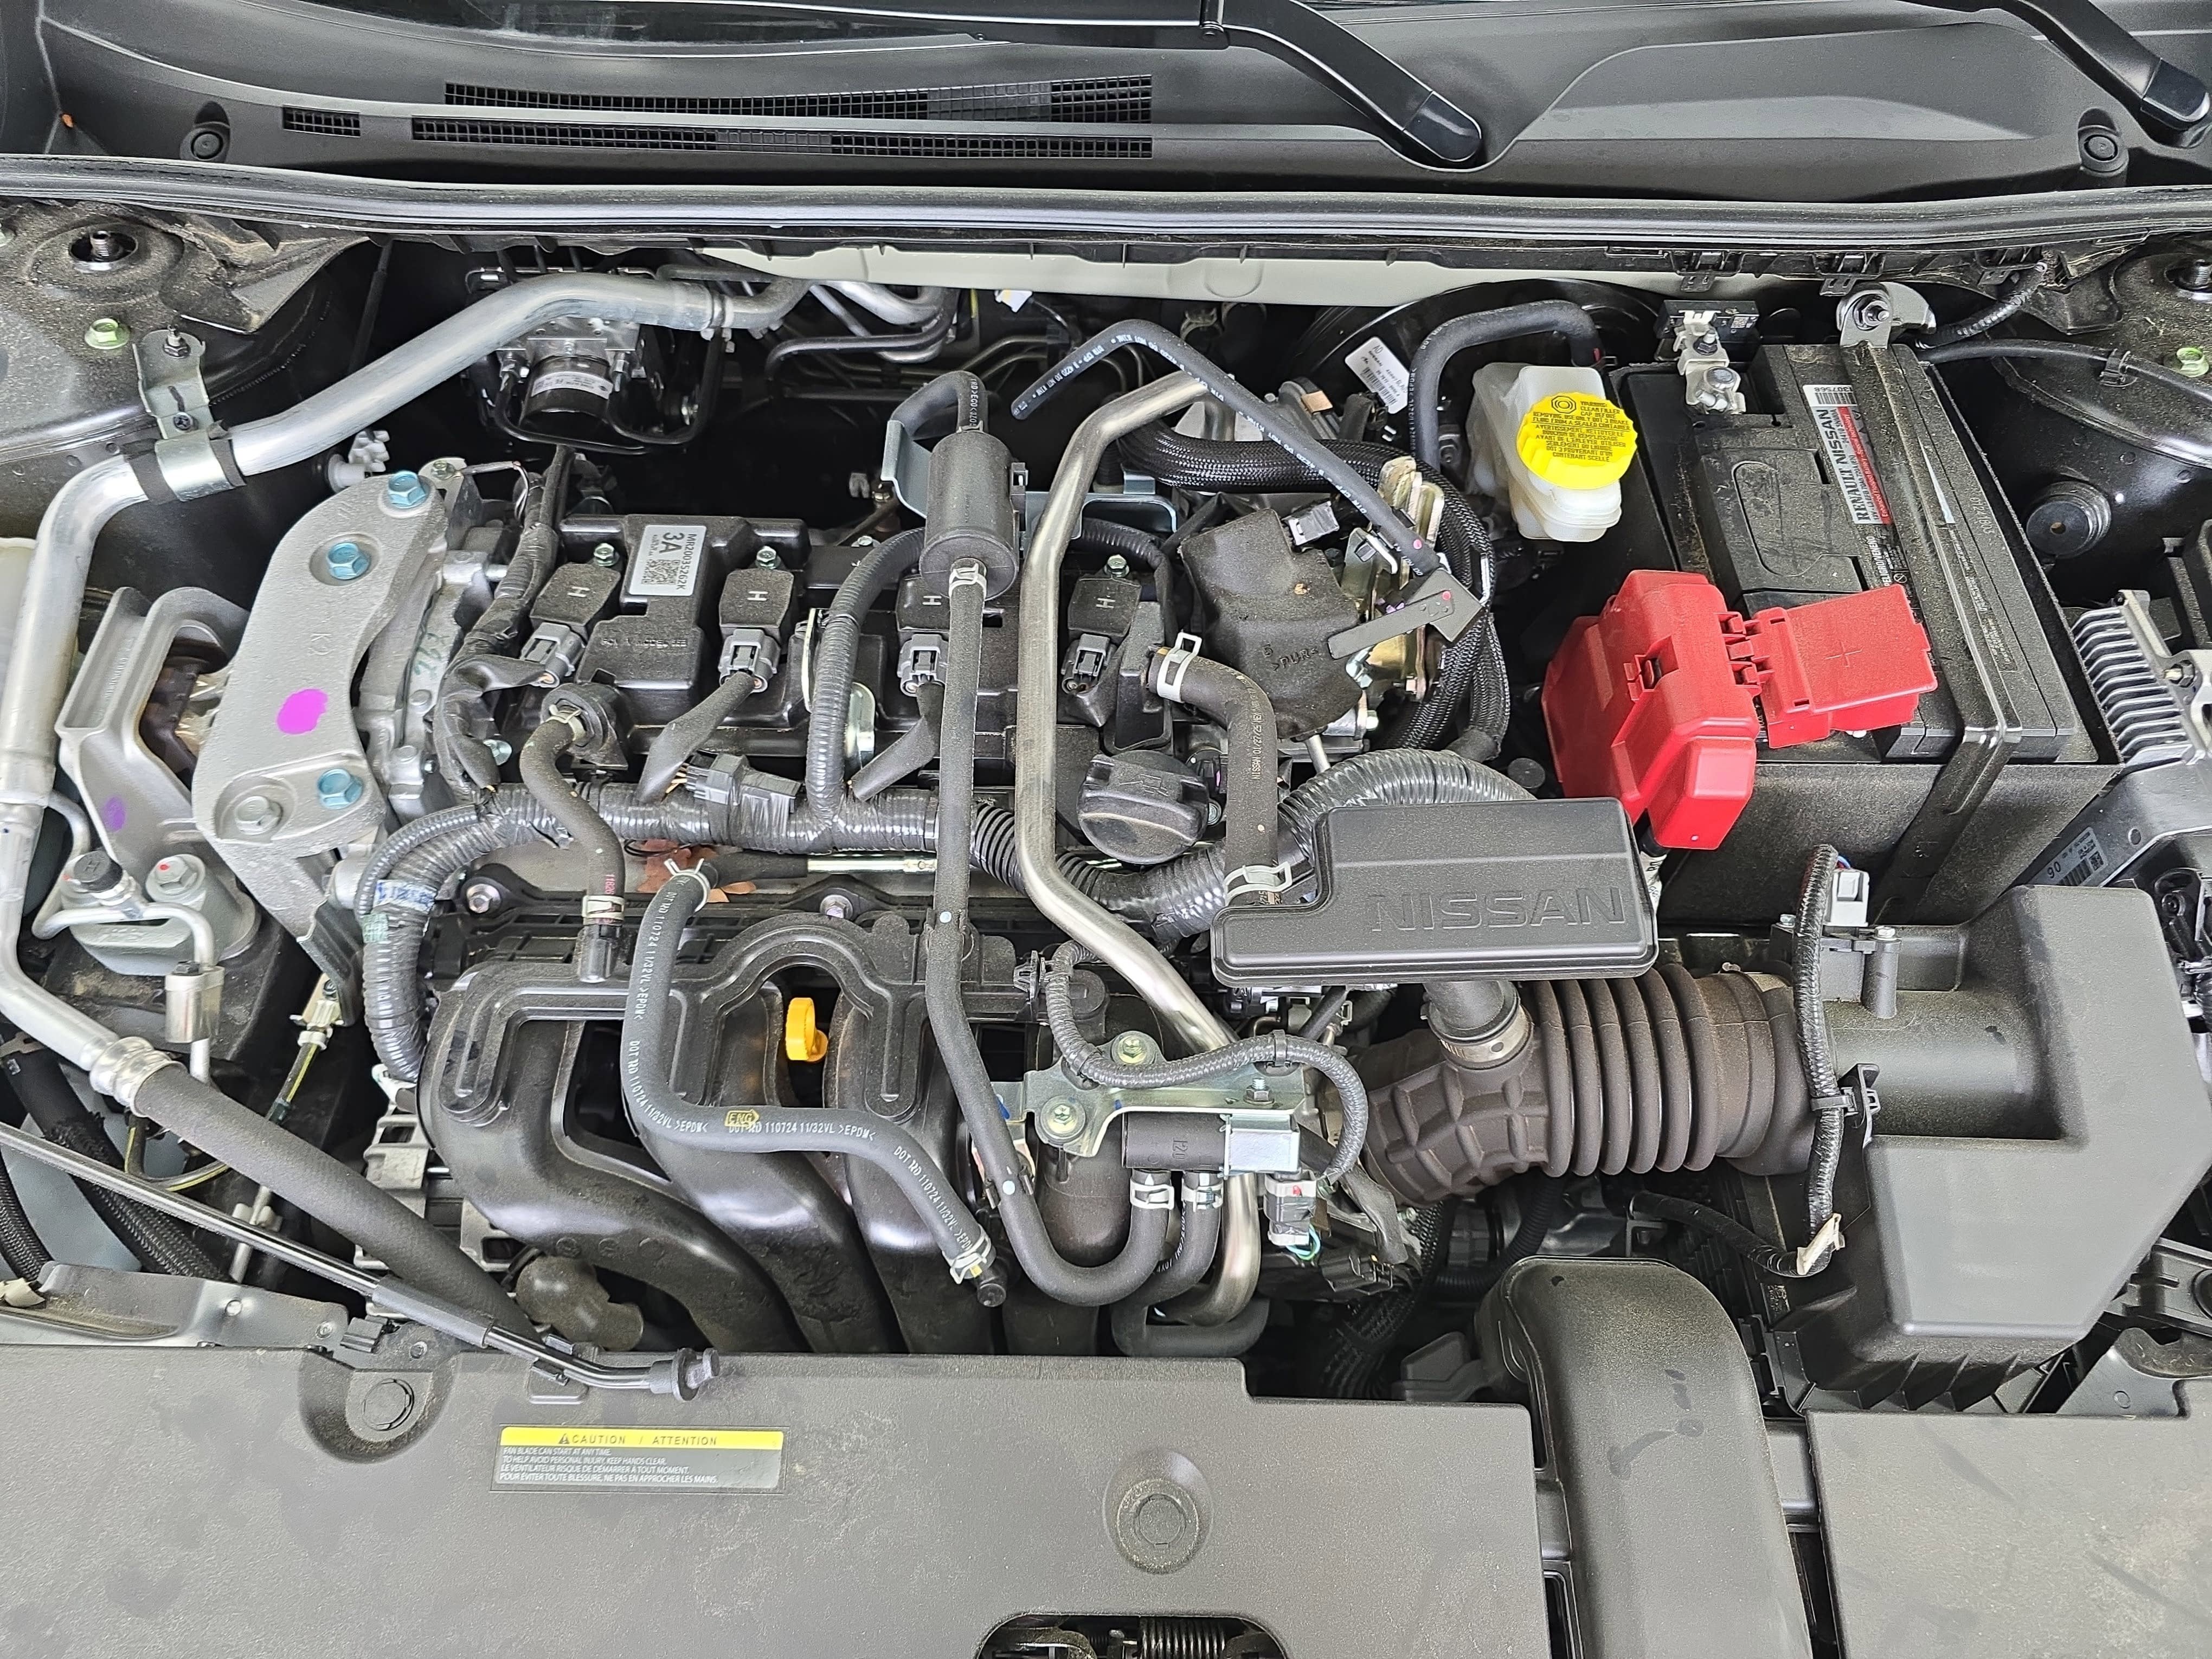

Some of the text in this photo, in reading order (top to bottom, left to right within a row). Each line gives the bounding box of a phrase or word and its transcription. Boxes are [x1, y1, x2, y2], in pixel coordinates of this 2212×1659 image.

[1816, 409, 1871, 522] RENAULT NISSAN
[659, 532, 685, 554] 3A
[1252, 758, 1262, 780] NISSAN
[2043, 860, 2063, 879] 90
[664, 891, 677, 904] DOT
[1372, 887, 1625, 932] NISSAN
[628, 1040, 641, 1057] DOT
[728, 1111, 753, 1122] ENG
[765, 1122, 798, 1133] 110724
[893, 1145, 912, 1163] DOT
[918, 1174, 942, 1204] 110724
[573, 1435, 626, 1444] CAUTION
[652, 1436, 717, 1445] ATTENTION
[538, 1447, 552, 1455] CAN
[552, 1448, 573, 1456] START
[572, 1448, 581, 1456] AT
[529, 1456, 550, 1464] AVOID
[550, 1456, 583, 1464] PERSONAL
[511, 1464, 556, 1472] VENTILATEUR
[556, 1464, 582, 1472] RISQUE
[638, 1465, 657, 1474] TOUT
[543, 1473, 568, 1481] TOUTE
[603, 1474, 614, 1482] NE
[614, 1474, 628, 1482] PAS
[628, 1474, 639, 1482] EN
[638, 1474, 681, 1483] APPROCHER
[680, 1475, 693, 1483] LES
